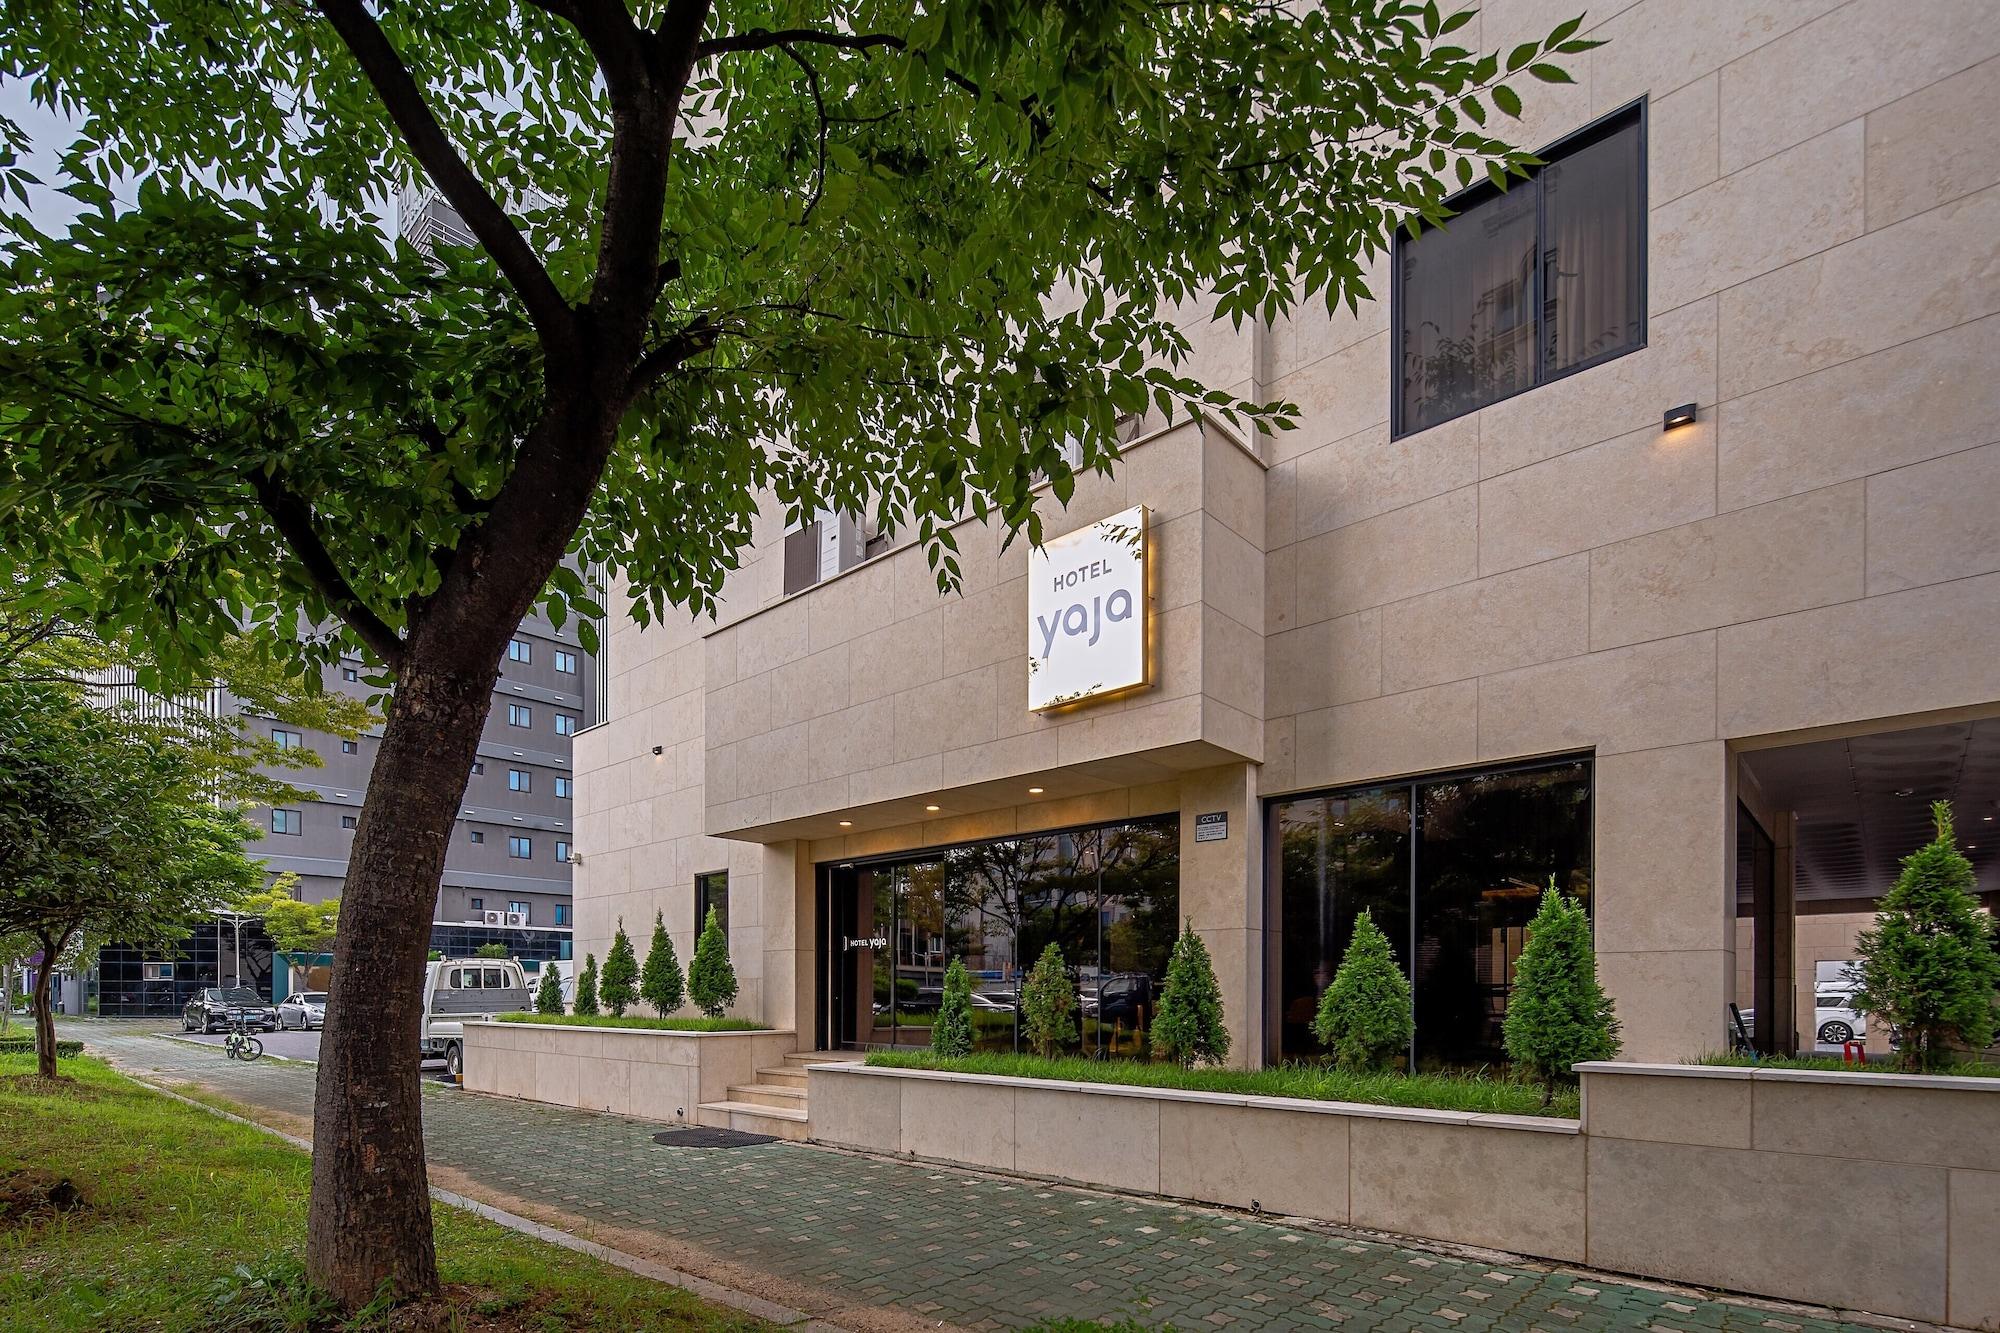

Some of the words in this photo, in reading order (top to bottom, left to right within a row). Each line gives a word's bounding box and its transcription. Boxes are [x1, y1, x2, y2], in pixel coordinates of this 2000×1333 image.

[1053, 559, 1112, 592] HOTEL
[1037, 589, 1132, 659] yaja
[1201, 814, 1222, 823] CCTV
[850, 939, 868, 947] HOTEL
[869, 937, 887, 949] yaja
